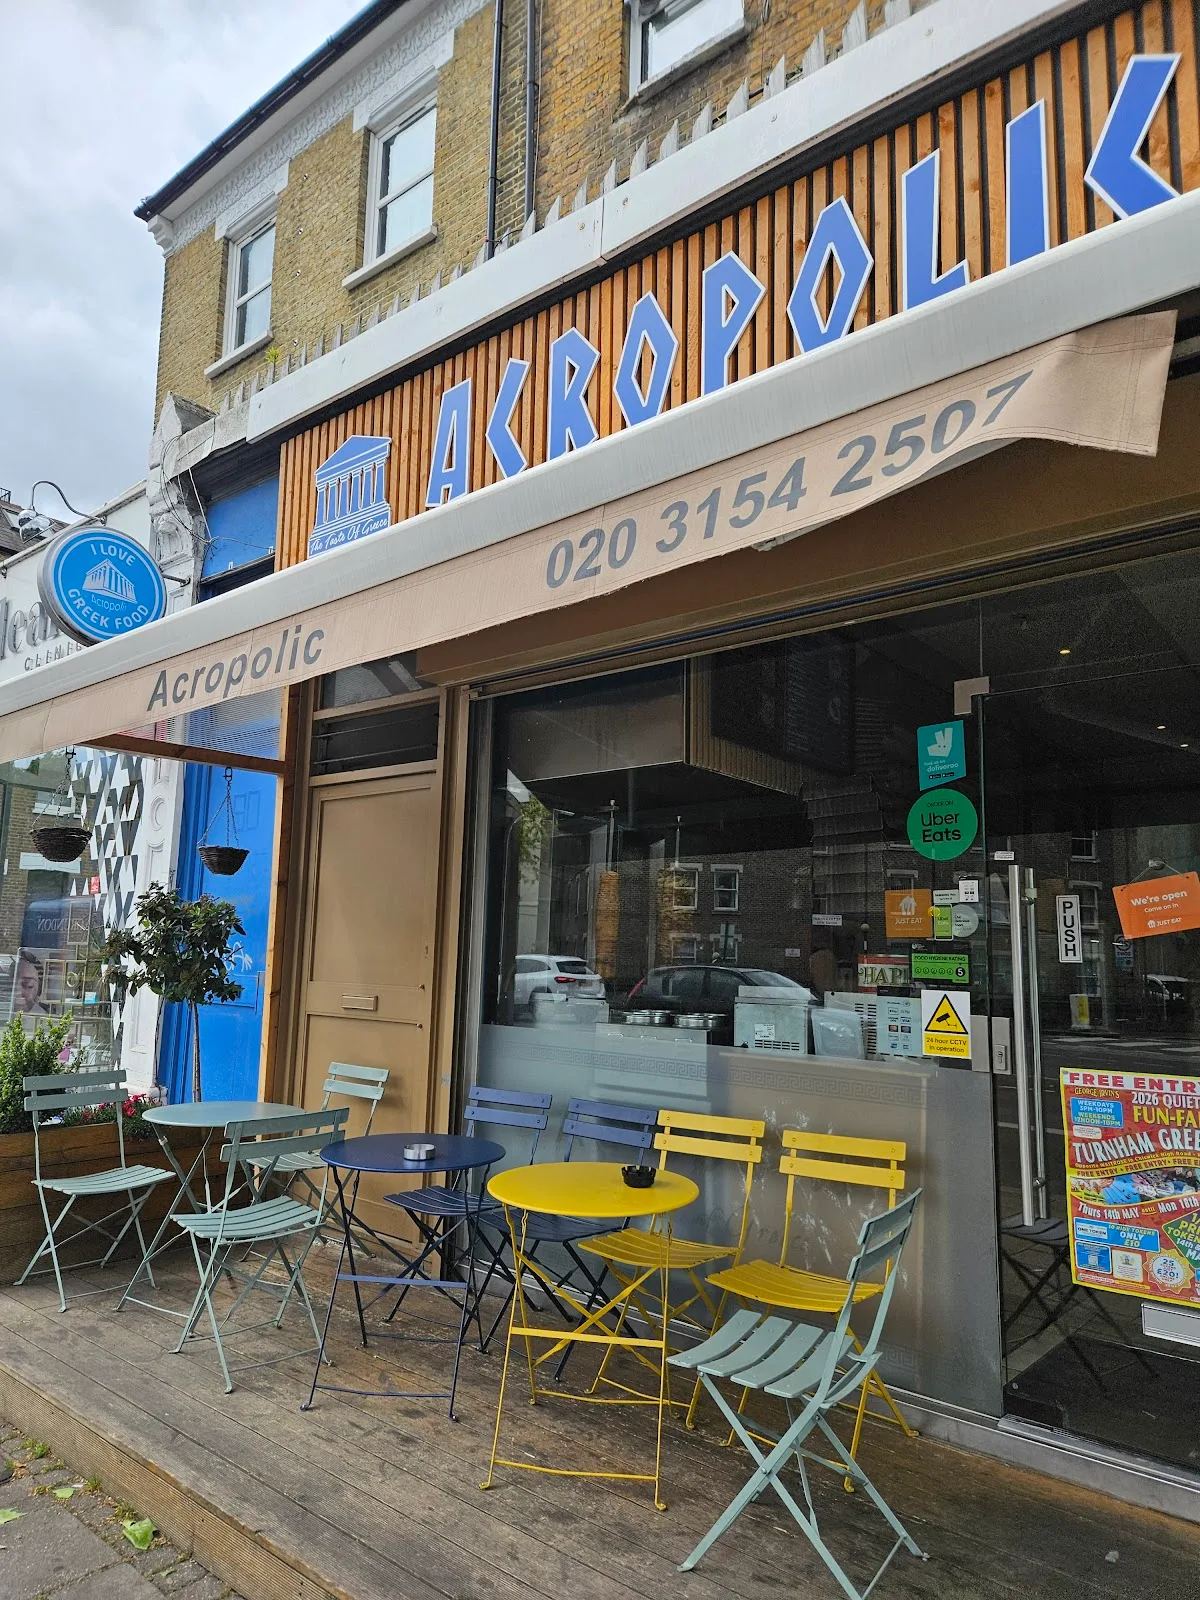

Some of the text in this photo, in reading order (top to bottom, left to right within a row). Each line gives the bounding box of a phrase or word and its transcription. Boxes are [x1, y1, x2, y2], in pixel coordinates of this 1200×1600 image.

[426, 53, 1181, 508] ACROPOLIC
[546, 370, 1033, 588] 020 3154 2507
[310, 518, 388, 554] The Taste Of Greece
[91, 544, 136, 566] I LOVE
[68, 588, 149, 630] GREEK FOOD
[146, 624, 325, 711] Acropolic
[927, 762, 959, 773] deliveroo
[920, 812, 960, 826] Uber
[922, 828, 962, 843] Eats
[1130, 890, 1188, 906] We're open
[1144, 905, 1162, 913] Come
[1062, 900, 1076, 957] PUSH
[1068, 1072, 1125, 1088] FREE
[1074, 1088, 1098, 1097] GEORGE
[1131, 1092, 1200, 1109] 2026 QUIET
[1077, 1100, 1114, 1108] WEEKDAYS
[1078, 1112, 1115, 1120] WEEKENDS
[1072, 1132, 1155, 1164] TURNHAM
[1125, 1160, 1166, 1172] FREE ENTRY
[1078, 1202, 1100, 1218] Thurs
[1104, 1208, 1120, 1219] 14th
[1122, 1207, 1139, 1219] MAY
[1158, 1202, 1177, 1214] Mon
[1179, 1196, 1199, 1209] 18th
[1120, 1231, 1144, 1241] ONLY
[1124, 1239, 1140, 1248] £10
[1176, 1238, 1193, 1248] 14th
